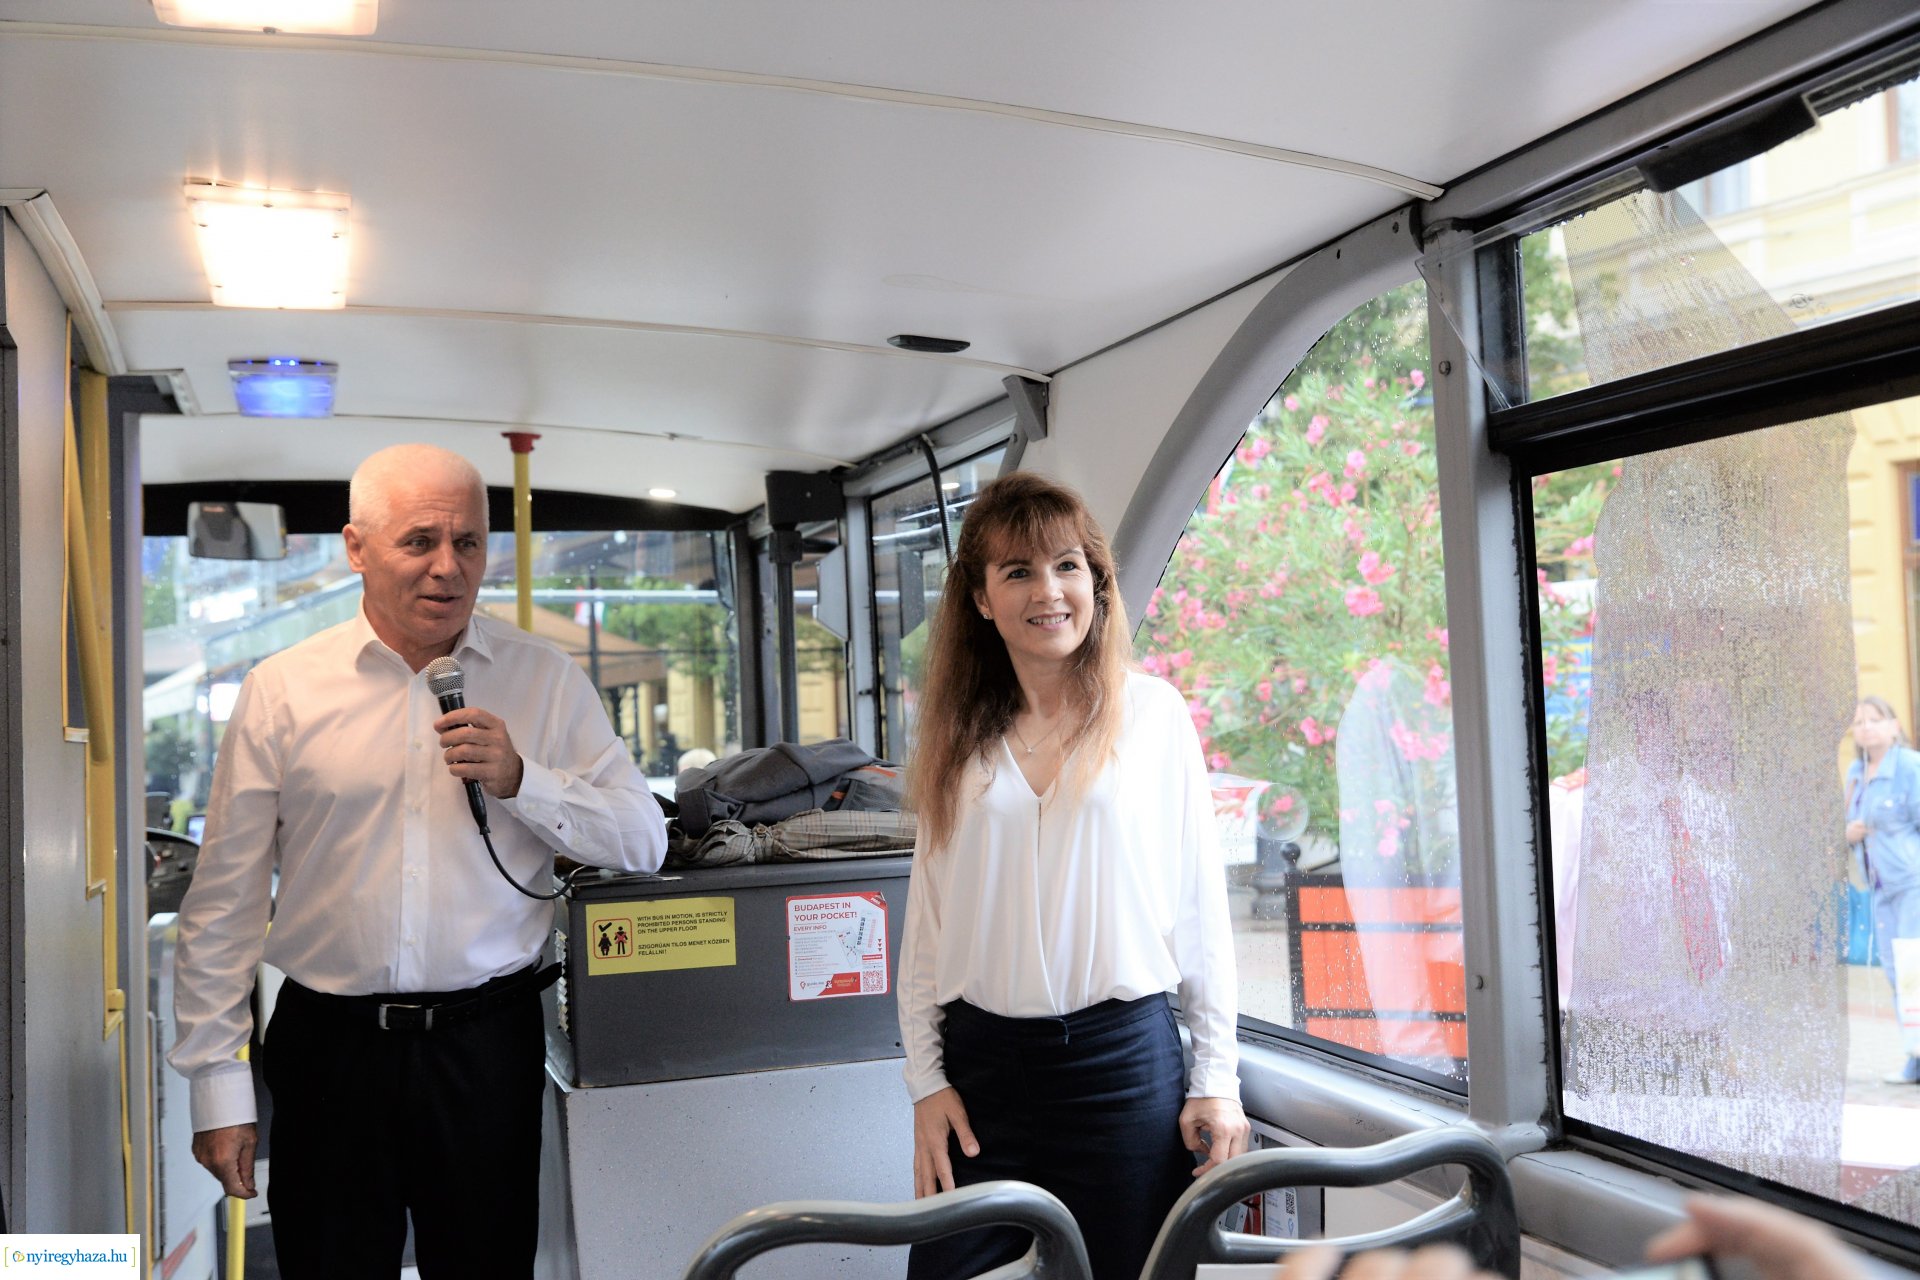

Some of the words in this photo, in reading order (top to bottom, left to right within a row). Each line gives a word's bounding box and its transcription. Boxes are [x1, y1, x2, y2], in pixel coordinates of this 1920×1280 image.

[794, 902, 840, 912] BUDAPEST
[842, 901, 851, 909] IN
[794, 913, 819, 922] YOUR
[820, 911, 857, 920] POCKET!
